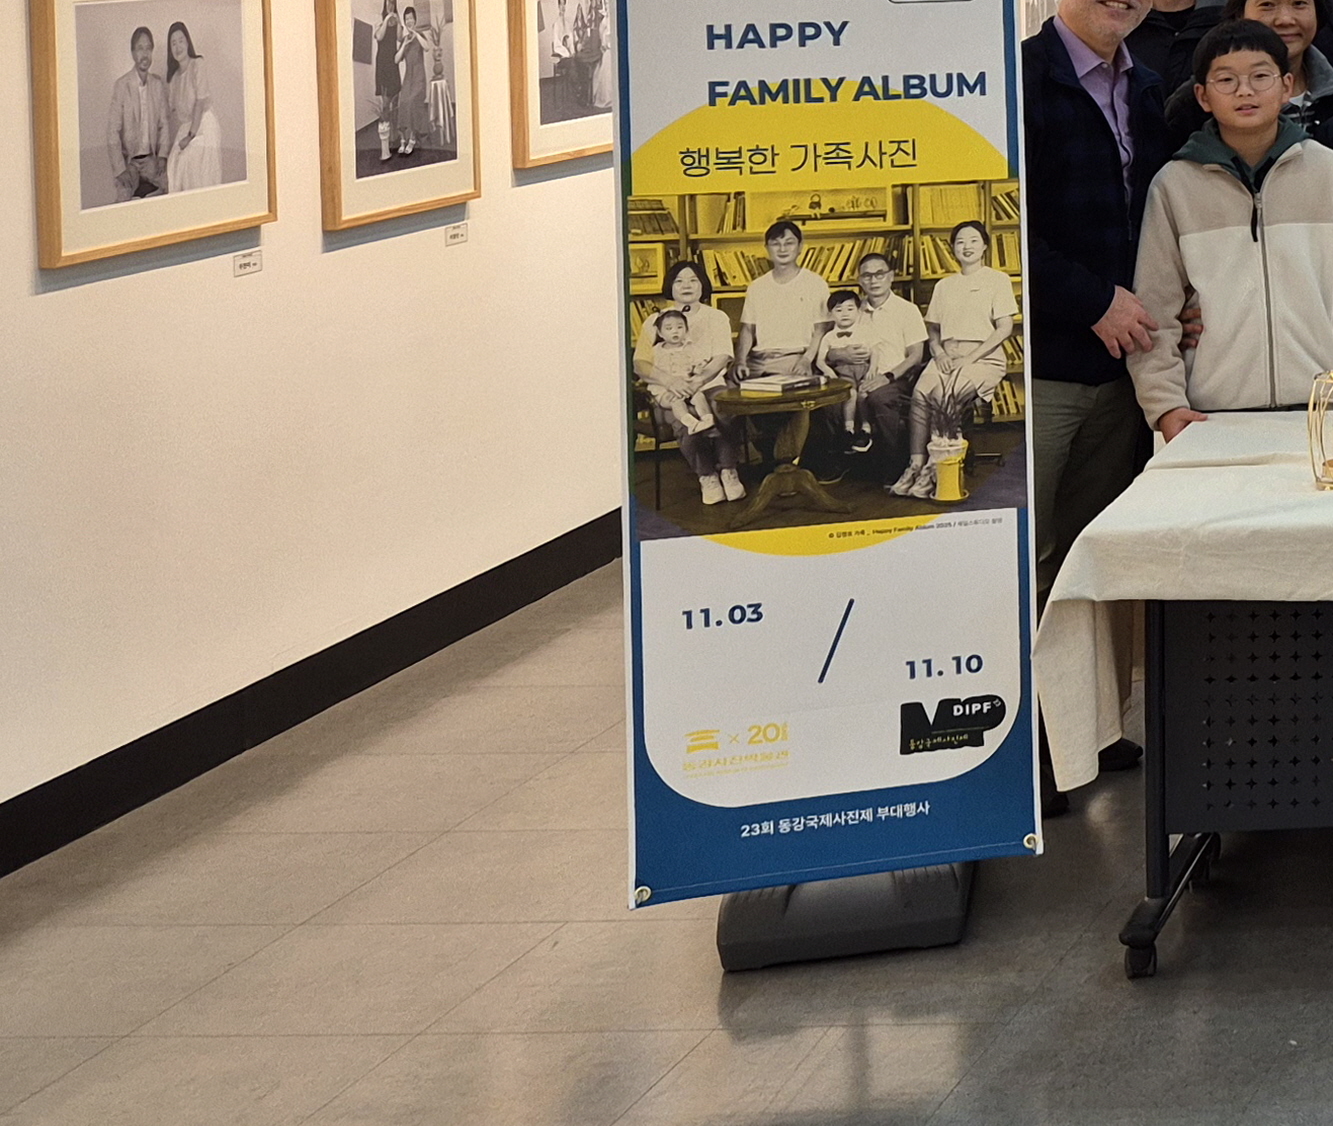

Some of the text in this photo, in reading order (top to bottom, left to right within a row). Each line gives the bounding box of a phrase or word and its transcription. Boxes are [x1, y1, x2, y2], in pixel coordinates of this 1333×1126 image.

[705, 20, 850, 50] HAPPY
[707, 71, 987, 107] FAMILY ALBUM
[678, 144, 780, 178] 행복한
[681, 602, 764, 631] 11.03
[905, 654, 984, 680] 11.10
[952, 701, 992, 717] DIPF
[740, 800, 931, 839] 23회 동강국제사진제 부대행사
